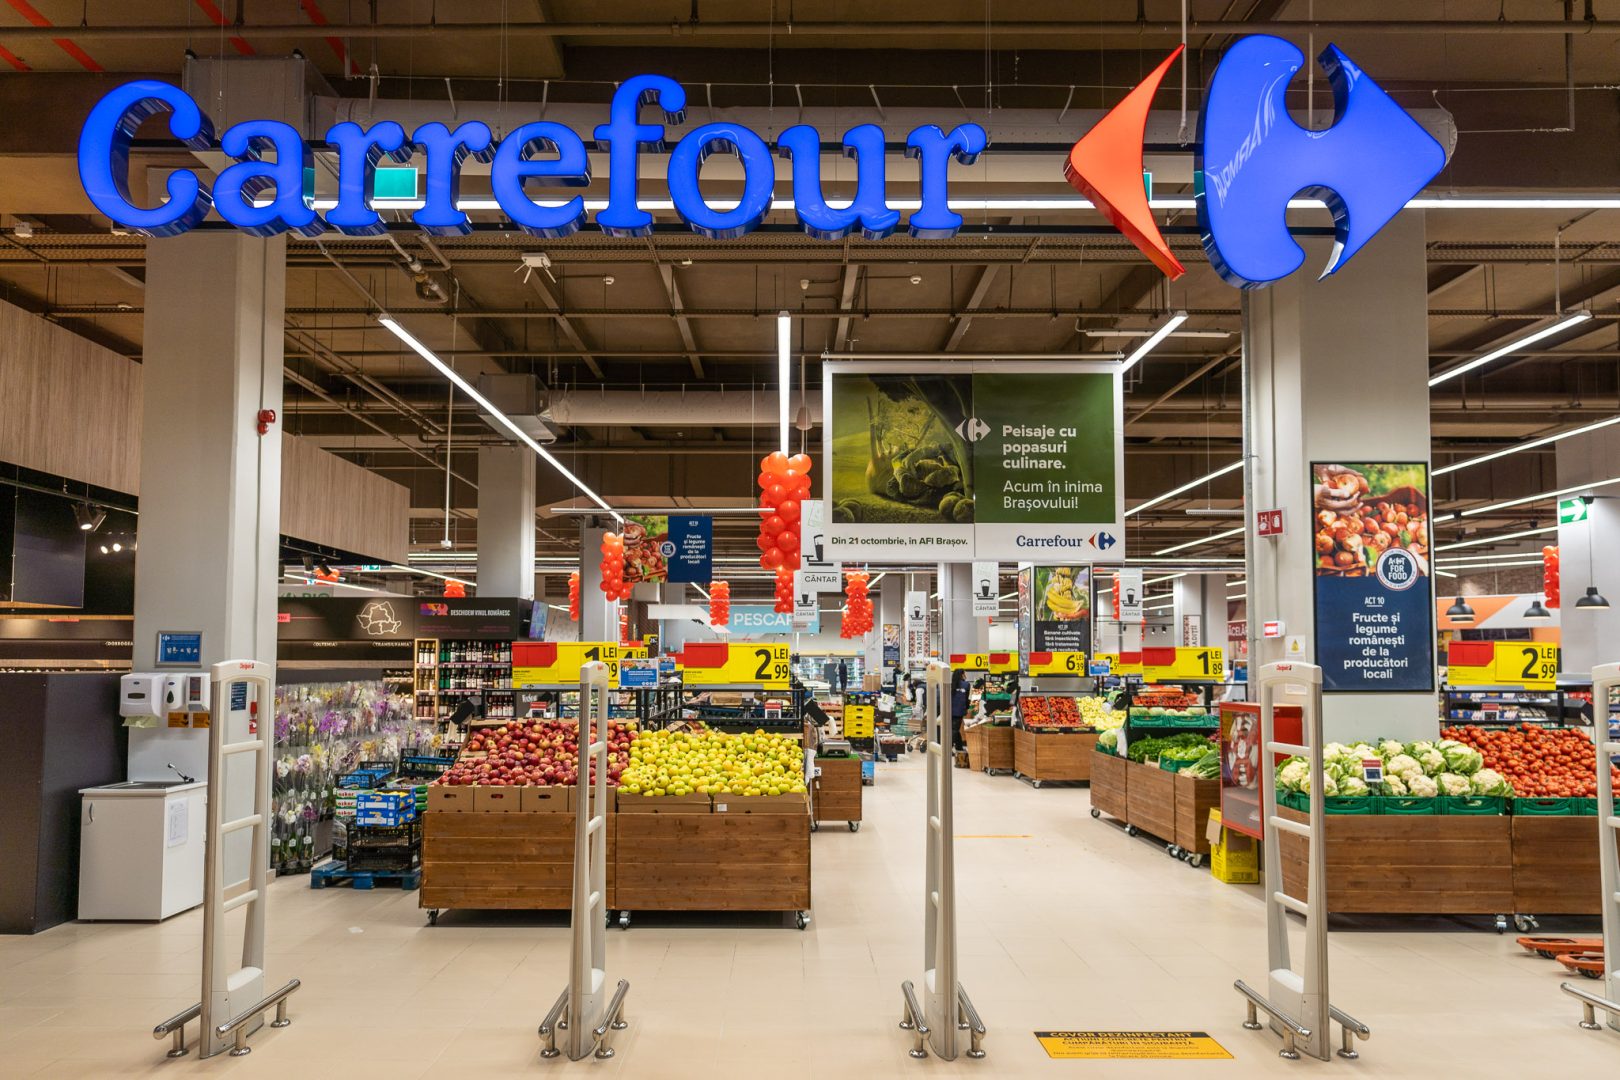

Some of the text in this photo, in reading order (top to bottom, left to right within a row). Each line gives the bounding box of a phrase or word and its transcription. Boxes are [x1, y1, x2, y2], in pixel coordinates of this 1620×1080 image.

[78, 74, 988, 238] Carrefour
[1002, 424, 1077, 440] Peisaje cu
[1002, 440, 1067, 456] popasuri
[1002, 456, 1067, 469] culinare.
[1003, 480, 1103, 493] Acum în inima
[831, 537, 847, 545] Din
[848, 537, 859, 545] 21
[860, 537, 907, 546] octombrie,
[918, 537, 934, 545] AFI
[1016, 534, 1083, 547] Carrefour
[1390, 565, 1405, 573] FOR
[804, 575, 838, 583] CÂNTAR
[1388, 572, 1408, 580] FOOD
[1364, 597, 1385, 605] ACT 10
[1352, 612, 1400, 625] Fructe și
[1355, 624, 1398, 635] legume
[1348, 635, 1405, 648] românești
[603, 647, 618, 658] LEI
[1362, 647, 1390, 656] de la
[754, 648, 789, 680] 2 LEI
[975, 655, 982, 667] 0
[1066, 655, 1076, 671] 6
[1076, 662, 1084, 671] 39
[1197, 651, 1222, 675] 1 LEI
[1343, 658, 1409, 669] producători
[1521, 647, 1556, 679] 2 LEI
[774, 664, 789, 679] 99
[1212, 663, 1223, 675] 89
[1363, 668, 1393, 679] locali
[1541, 664, 1556, 679] 99
